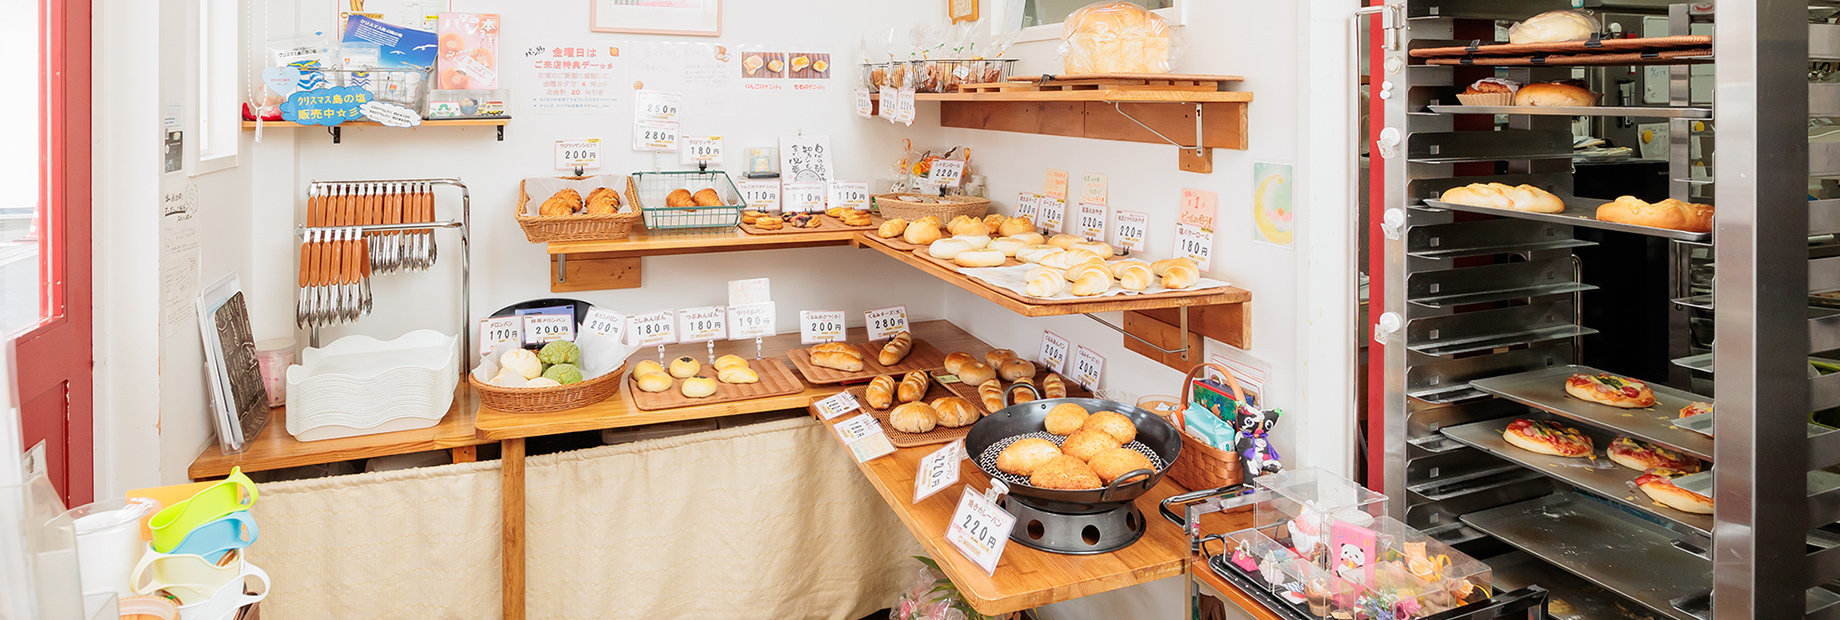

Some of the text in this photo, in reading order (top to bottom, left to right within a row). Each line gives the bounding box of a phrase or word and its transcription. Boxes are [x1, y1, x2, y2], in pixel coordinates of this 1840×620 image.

[552, 47, 597, 57] 金曜日は
[297, 93, 367, 106] クリスマス島の塩
[647, 103, 677, 114] 250円
[644, 130, 675, 141] 280円
[565, 150, 596, 159] 200円
[691, 146, 720, 155] 180円
[935, 168, 959, 178] 220円
[747, 191, 776, 200] 110円
[792, 193, 821, 202] 110円
[838, 191, 866, 200] 110円
[1018, 203, 1036, 215] 200円
[1042, 208, 1062, 221] 180円
[1082, 216, 1103, 229] 220円
[1119, 225, 1142, 238] 220円
[1181, 238, 1208, 257] 180円
[633, 314, 667, 324] こしあんぱん
[685, 312, 719, 320] つぶあんぱん
[738, 316, 770, 327] 190円
[490, 320, 513, 328] メロンパン
[590, 320, 619, 334] 200円
[689, 320, 721, 331] 180円
[811, 322, 842, 332] 200円
[875, 317, 904, 329] 280円
[489, 328, 518, 340] 170円
[535, 325, 569, 335] 200円
[637, 323, 670, 335] 180円
[1044, 344, 1063, 362] 200円
[1078, 360, 1098, 379] 200円
[931, 455, 945, 488] 220円
[967, 499, 1003, 528] 焼きカレーパン
[962, 514, 997, 549] 220円
